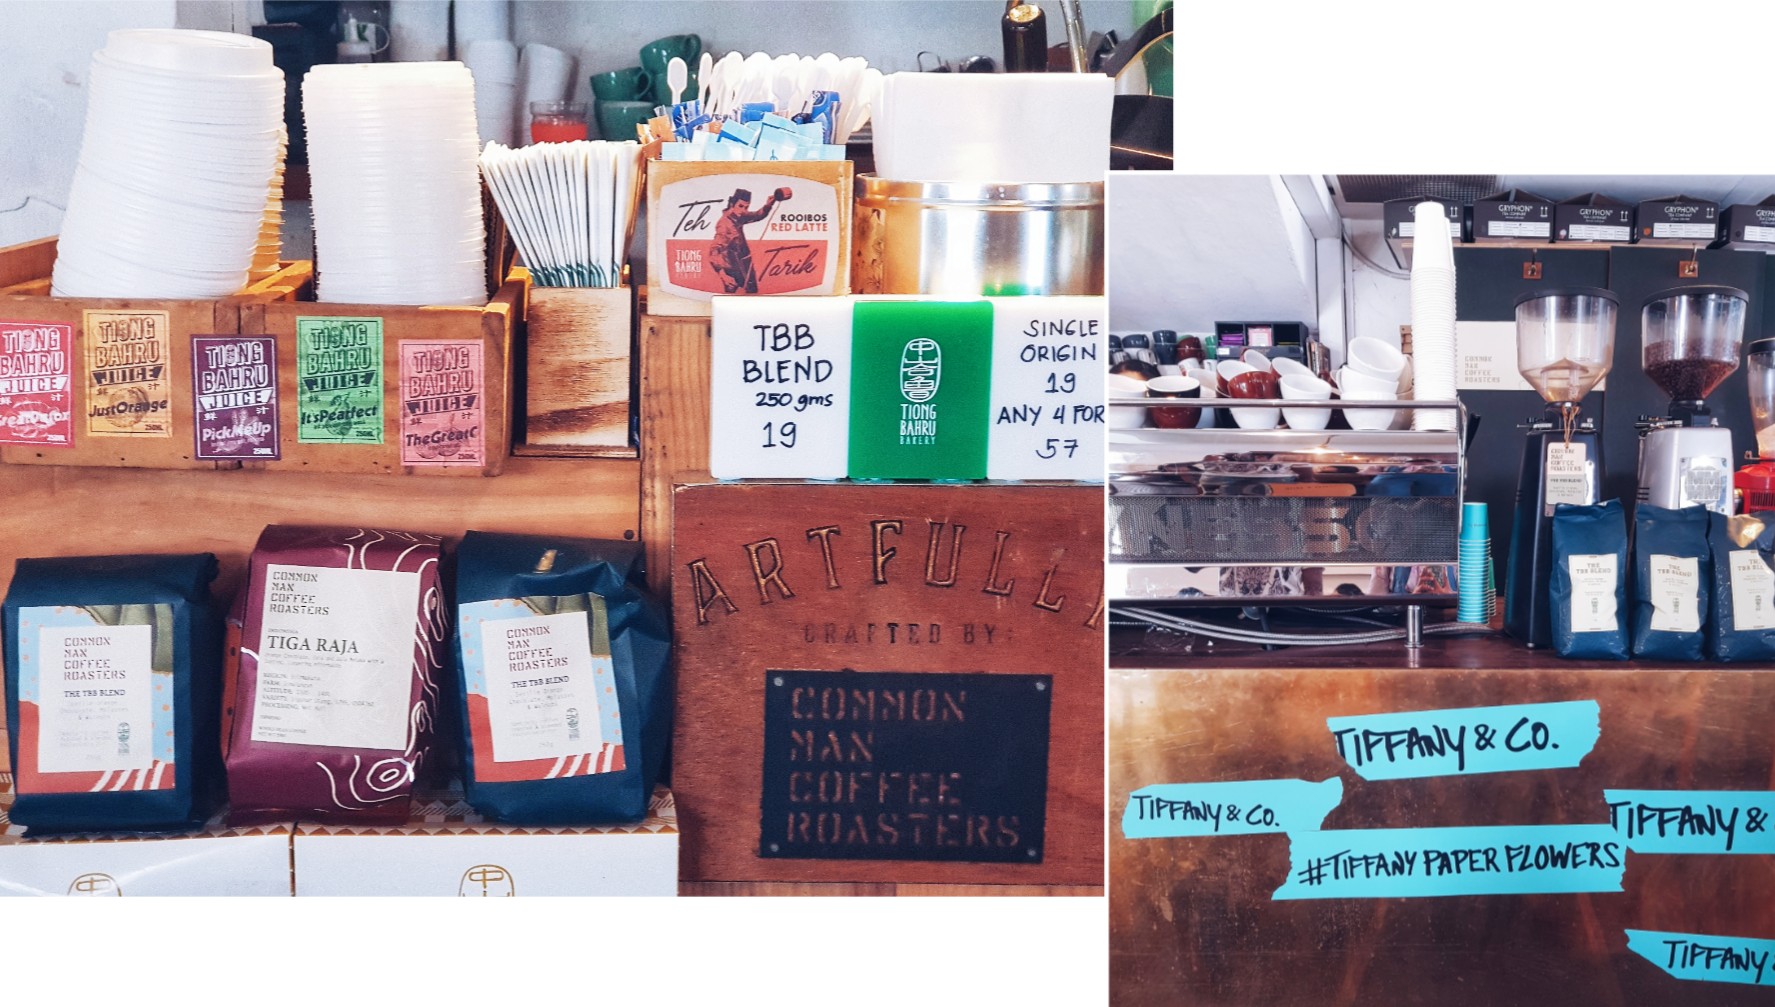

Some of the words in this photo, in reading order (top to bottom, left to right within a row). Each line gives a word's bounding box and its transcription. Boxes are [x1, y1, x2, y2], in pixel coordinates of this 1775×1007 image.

[673, 199, 724, 237] Teh
[771, 222, 790, 232] RED
[795, 222, 828, 232] LATTE
[780, 213, 828, 222] ROOIBOS
[758, 245, 819, 282] Tarik
[99, 317, 156, 343] TIONG
[311, 324, 368, 350] TIONG
[754, 323, 815, 352] TBB
[1023, 319, 1099, 337] SINGLE
[2, 327, 60, 354] TIONG
[95, 341, 159, 368] BAHRU
[206, 341, 264, 368] TIONG
[307, 347, 371, 375] BAHRU
[414, 347, 470, 374] TIONG
[1019, 343, 1097, 363] ORIGIN
[0, 351, 64, 378] BAHRU
[743, 356, 833, 383] BLEND
[202, 364, 268, 393] BAHRU
[409, 370, 474, 398] BAHRU
[1045, 372, 1076, 394] 19
[210, 390, 263, 411] JUICE
[755, 392, 793, 408] 250
[795, 393, 834, 412] gms
[900, 403, 938, 420] TIONG
[996, 404, 1042, 427] ANY
[1052, 404, 1066, 425] 4
[1073, 404, 1105, 425] FOR
[762, 422, 797, 449] 19
[899, 420, 937, 436] BAHRU
[899, 436, 936, 445] BAKERY
[1036, 438, 1079, 459] 57
[271, 582, 295, 592] MAN
[273, 571, 318, 582] COMMON
[271, 593, 316, 604] COFFEE
[269, 604, 330, 616] ROASTERS
[64, 637, 111, 647] COMMON
[506, 625, 551, 639] COMMON
[804, 622, 942, 644] CRAFTED
[64, 648, 88, 658] MAN
[267, 635, 311, 651] TIGA
[316, 638, 359, 655] RAJA
[507, 639, 531, 650] MAN
[508, 647, 553, 661] COFFEE
[64, 659, 110, 670] COFFEE
[64, 670, 126, 681] ROASTERS
[508, 657, 569, 672] ROASTERS
[510, 681, 528, 689] THE
[791, 686, 967, 722] COMMON
[790, 729, 874, 762] MAN
[1333, 724, 1466, 771] TIFFANY
[1474, 723, 1496, 751] &
[1505, 717, 1560, 753] CO.
[789, 770, 960, 805] COFFEE
[1131, 795, 1222, 832] TIFFANY
[1226, 804, 1242, 821] &
[1245, 804, 1280, 827] CO.
[786, 812, 1020, 847] ROASTERS
[1609, 801, 1739, 851] TIFFANY
[1745, 806, 1769, 833] &
[1297, 849, 1417, 886] #TIFFANY
[1422, 847, 1501, 876] PAPER
[1504, 842, 1620, 873] FLOWERS
[1662, 940, 1769, 984] TIFFANY
